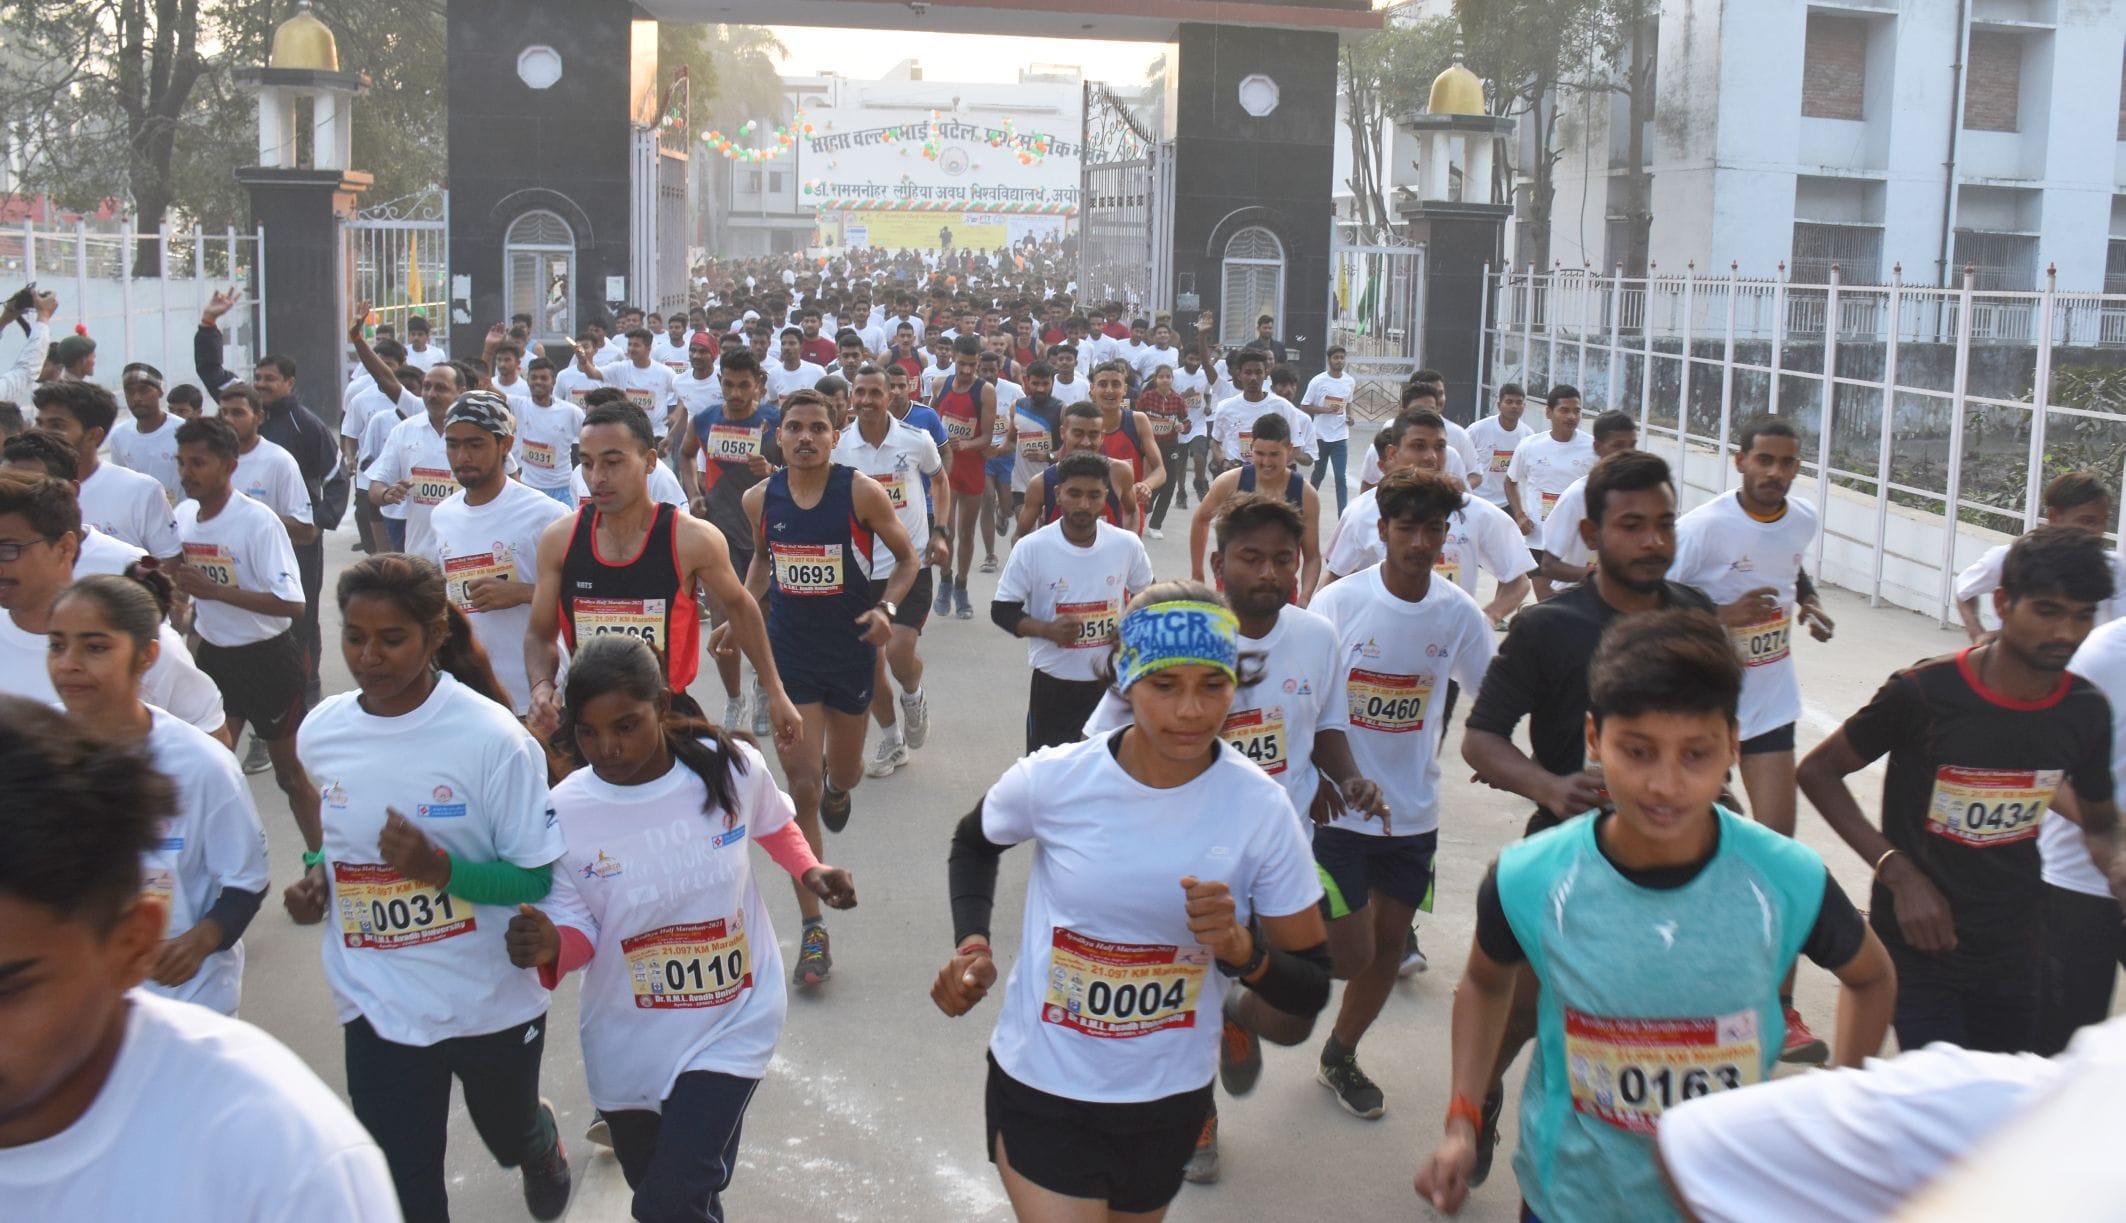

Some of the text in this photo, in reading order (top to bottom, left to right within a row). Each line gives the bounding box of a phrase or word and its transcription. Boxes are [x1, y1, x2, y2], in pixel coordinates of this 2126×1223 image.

[938, 118, 978, 141] पटेल
[948, 423, 972, 436] 0802
[528, 451, 551, 463] 0331
[721, 440, 755, 454] 0587
[422, 483, 454, 497] 0001
[788, 565, 836, 584] 0693
[1368, 697, 1420, 719] 0460
[1231, 735, 1277, 761] 345
[1966, 801, 2042, 829] 0434
[371, 892, 454, 932] 0031
[421, 920, 466, 940] University
[662, 946, 692, 956] 21.097
[694, 943, 710, 954] KM
[665, 949, 742, 991] 0110
[1090, 965, 1204, 979] 21.097 KM Marathon
[689, 991, 714, 1002] Avadh
[1087, 978, 1186, 1019] 0004
[1619, 1062, 1741, 1108] 0163
